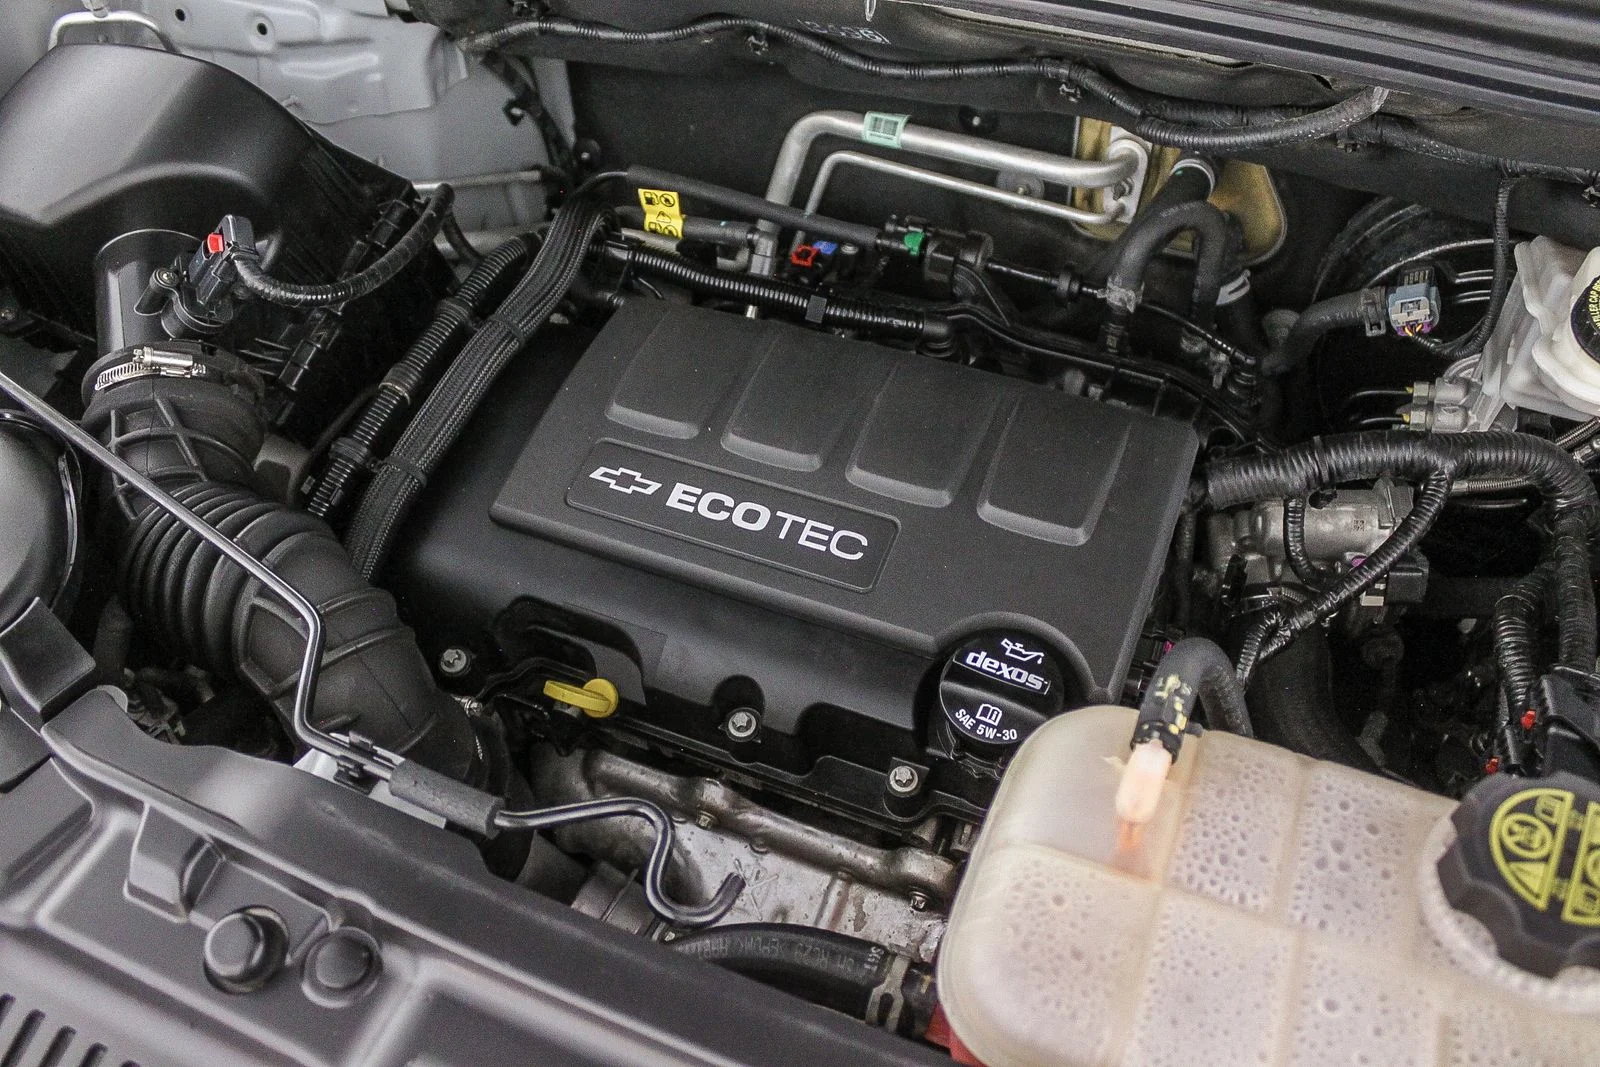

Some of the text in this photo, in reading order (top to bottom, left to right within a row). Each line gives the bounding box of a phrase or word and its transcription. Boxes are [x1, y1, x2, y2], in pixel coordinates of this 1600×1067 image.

[666, 482, 868, 560] ECOTEC
[965, 650, 1045, 690] dexos
[955, 708, 1018, 740] SAE 5W-30
